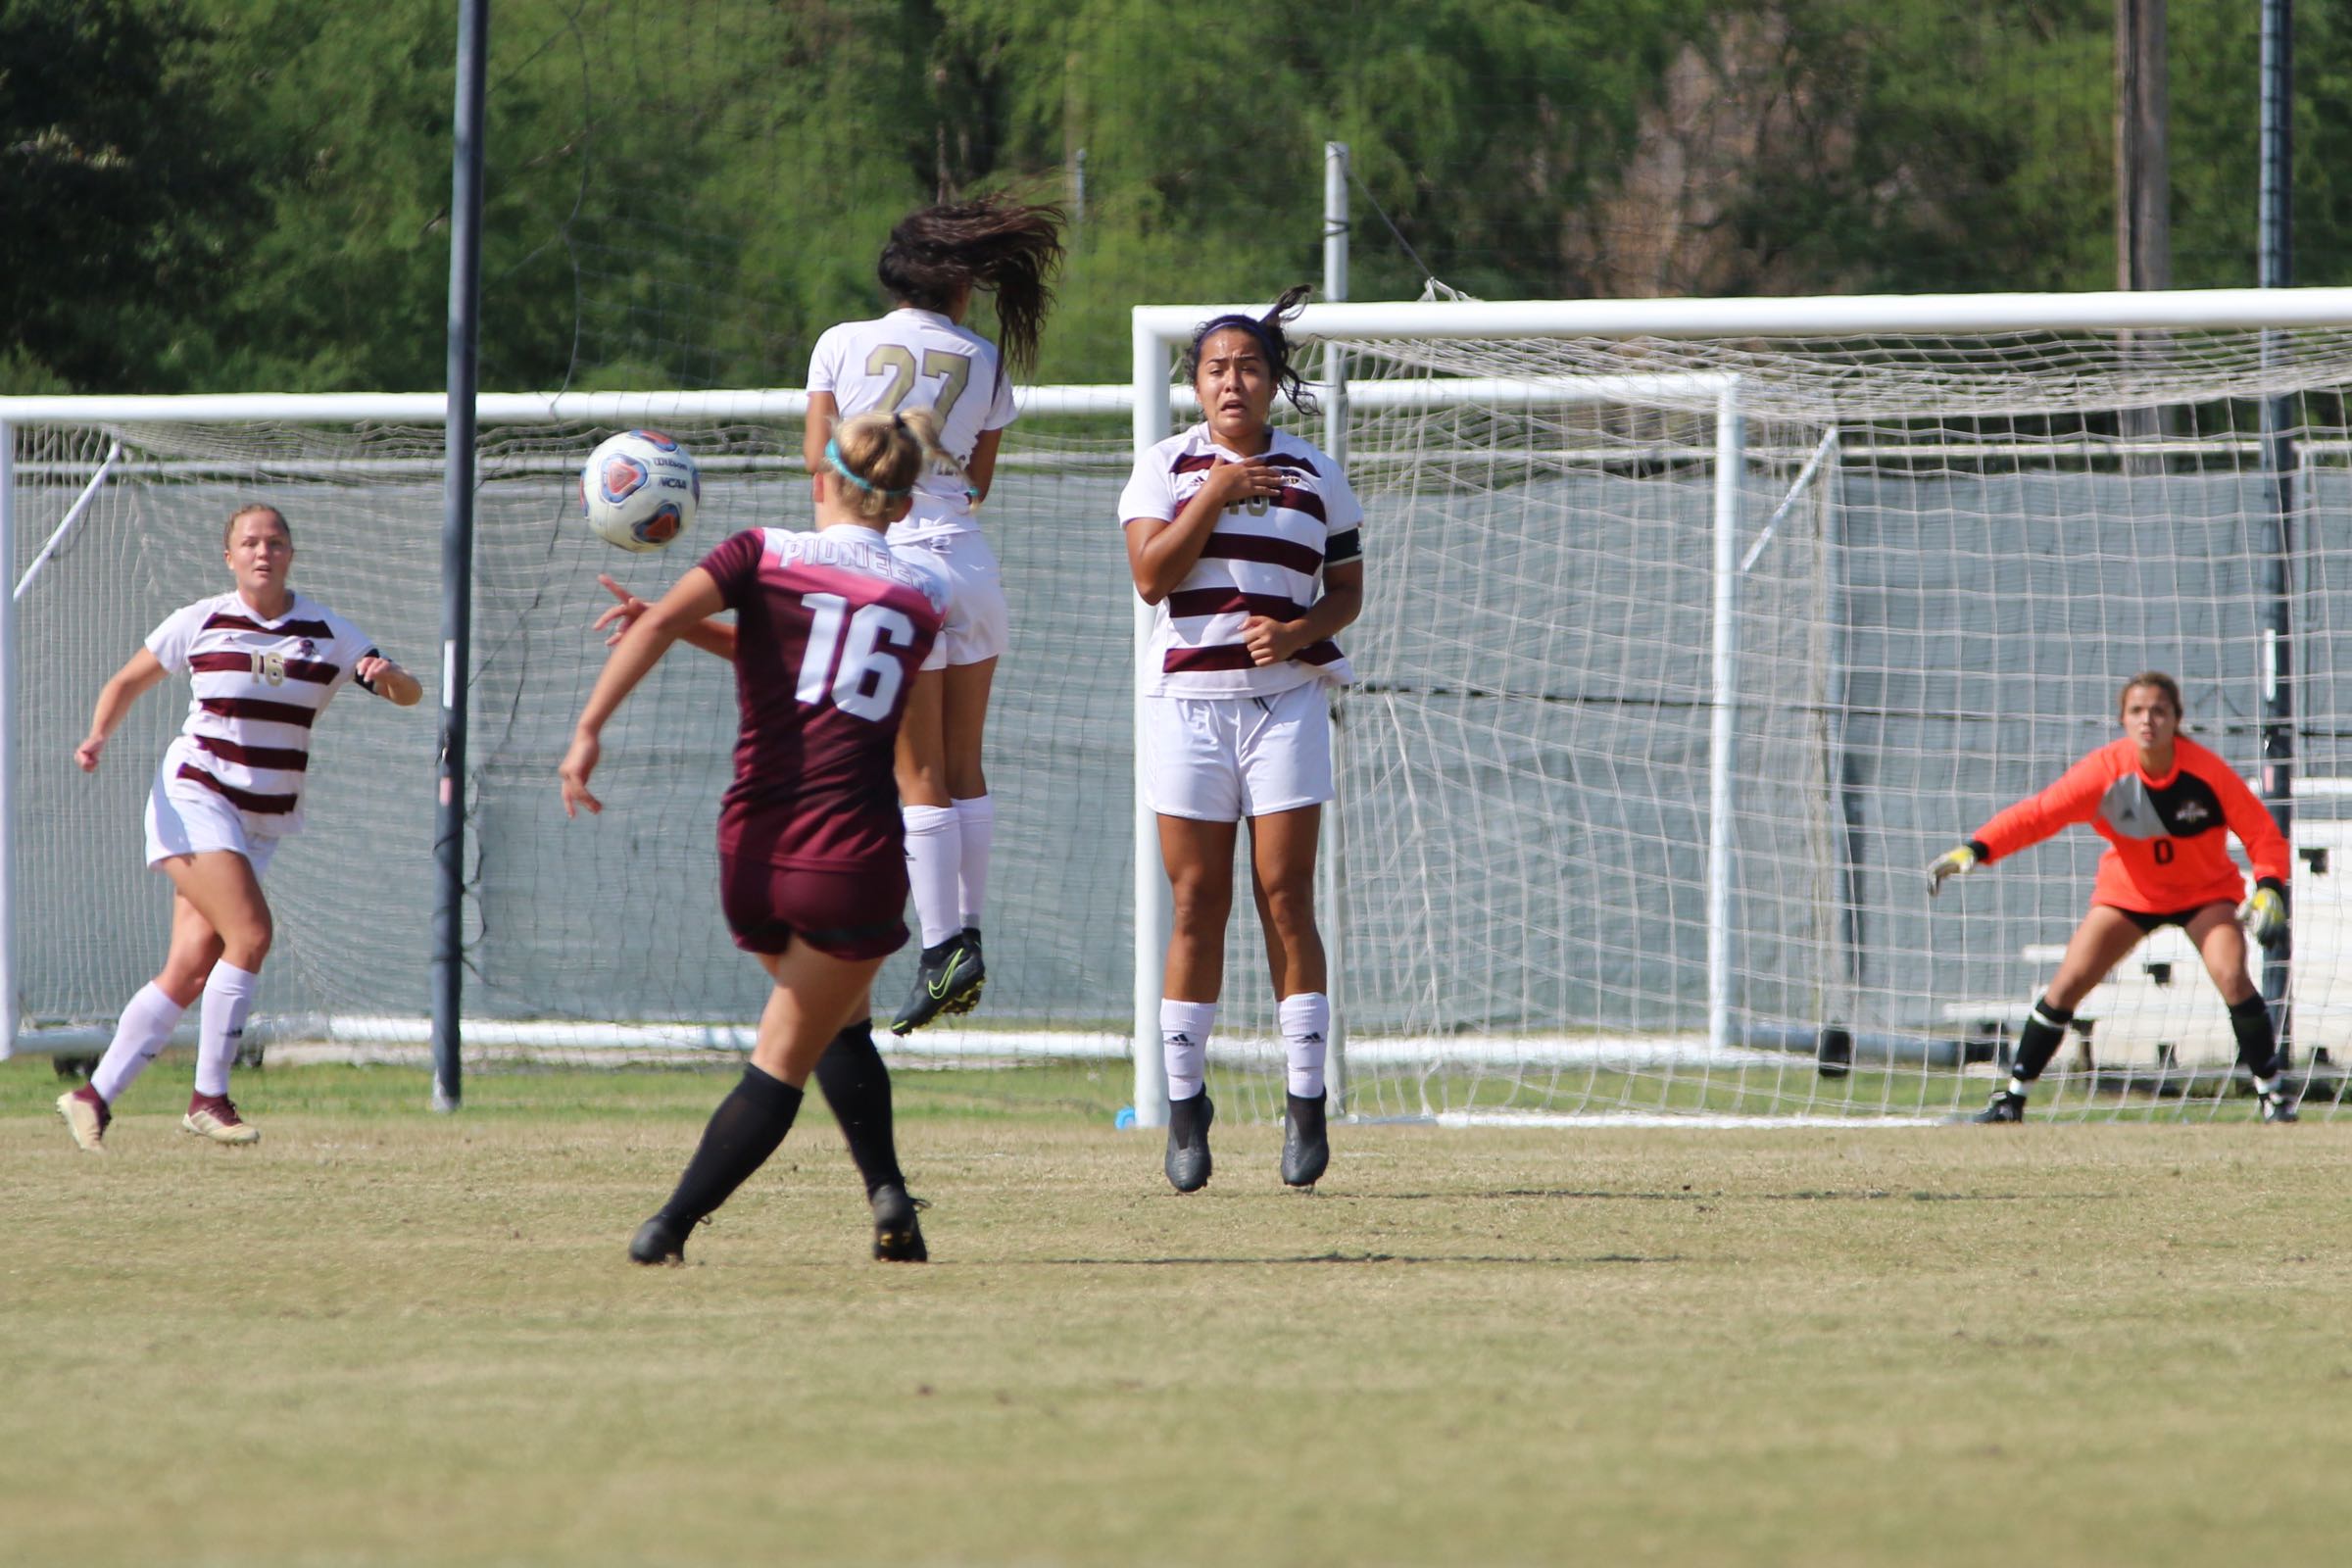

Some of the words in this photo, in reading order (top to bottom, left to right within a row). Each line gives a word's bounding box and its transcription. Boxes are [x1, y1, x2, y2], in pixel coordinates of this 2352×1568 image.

[864, 343, 971, 436] 27
[653, 457, 688, 471] Wilson
[658, 476, 687, 490] NCAA
[251, 649, 285, 687] 16
[795, 592, 914, 723] 16
[2153, 838, 2175, 865] 0
